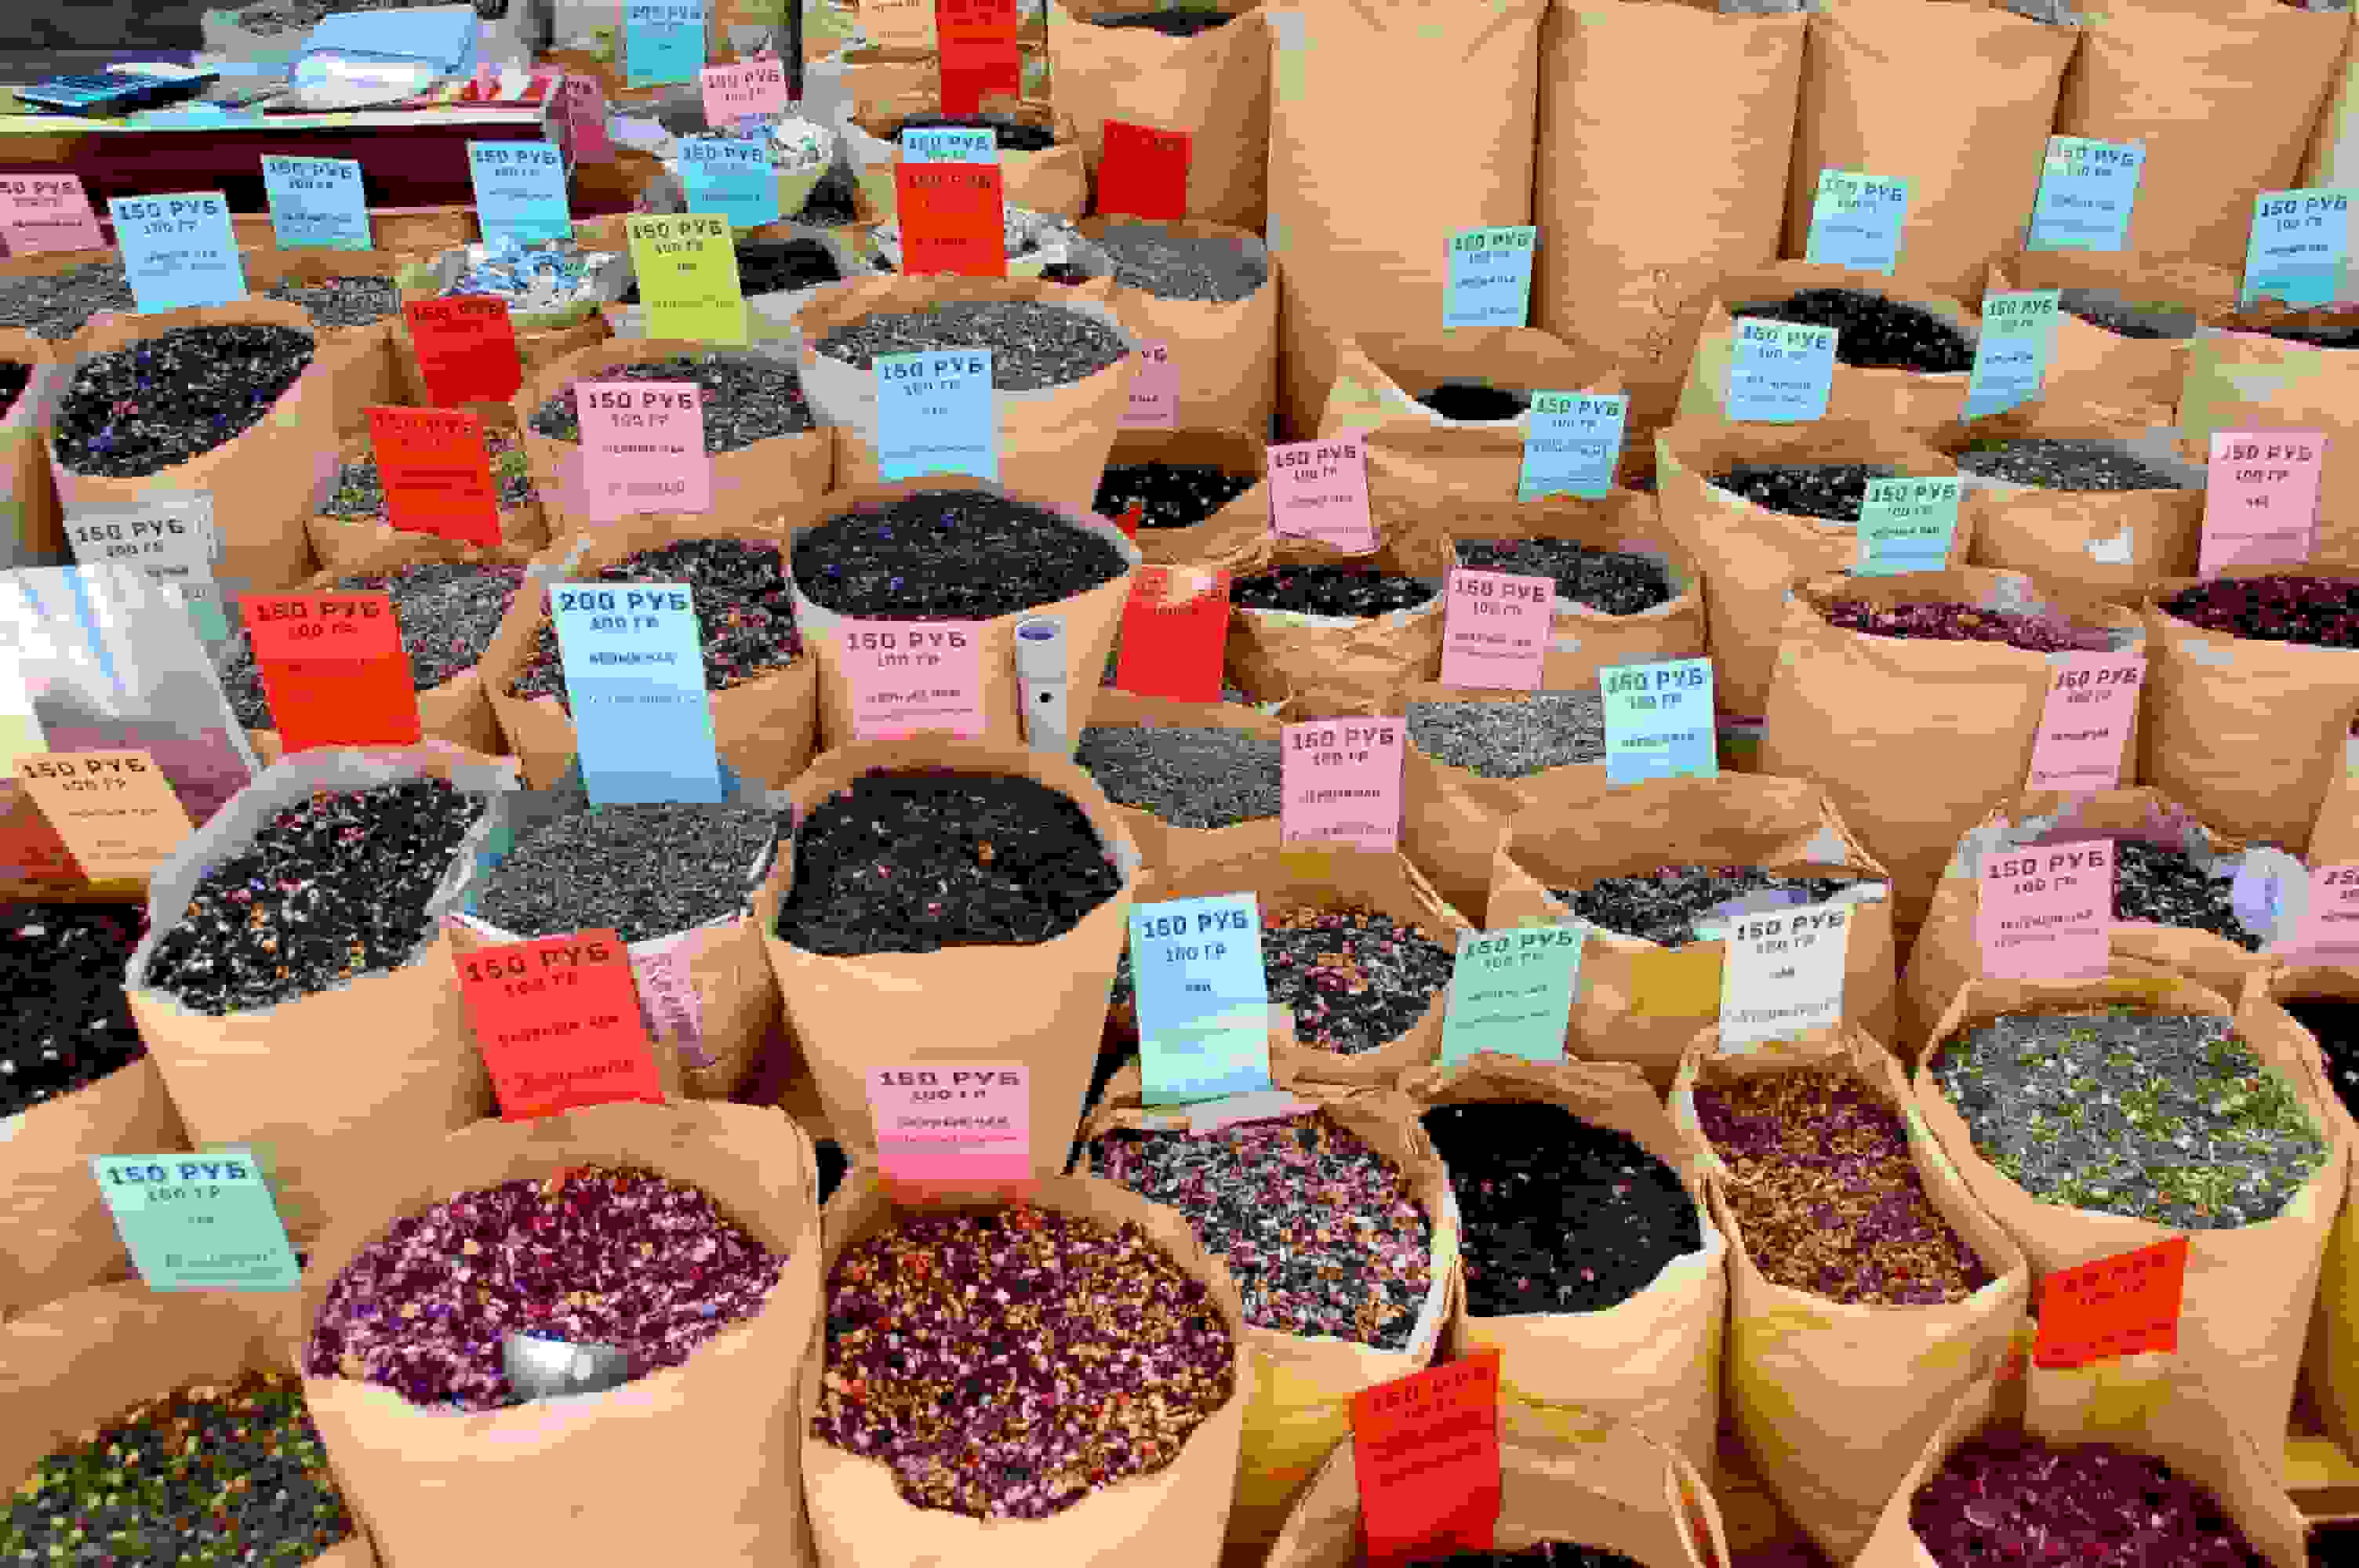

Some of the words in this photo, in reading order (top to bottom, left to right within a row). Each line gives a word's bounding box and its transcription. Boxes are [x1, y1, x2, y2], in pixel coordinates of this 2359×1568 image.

[119, 202, 162, 220] 150
[169, 200, 218, 218] РУБ
[2260, 199, 2298, 218] 150
[2306, 194, 2348, 212] РУБ
[632, 221, 672, 239] 150
[678, 219, 722, 238] РУБ
[883, 363, 924, 381] 150
[934, 358, 983, 379] РУБ
[590, 391, 631, 409] 150
[643, 391, 694, 409] РУБ
[1535, 398, 1570, 415] 150
[1579, 400, 1621, 418] РУБ
[1274, 449, 1310, 468] 150
[1317, 444, 1357, 463] РУБ
[2220, 444, 2260, 464] 150
[2265, 444, 2314, 464] РУБ
[1869, 483, 1909, 503] 150
[1914, 481, 1958, 502] РУБ
[76, 524, 122, 543] 150
[132, 518, 185, 540] РУБ
[559, 591, 617, 613] 200
[627, 590, 685, 612] РУБ
[1454, 579, 1494, 600] 150
[1501, 583, 1545, 603] РУБ
[256, 602, 304, 622] 150
[319, 601, 381, 619] РУБ
[846, 633, 897, 652] 150
[909, 631, 967, 650] РУБ
[1607, 672, 1646, 693] 150
[1656, 668, 1704, 691] РУБ
[2056, 669, 2092, 689] 150
[2095, 666, 2139, 687] РУБ
[1292, 730, 1335, 750] 150
[1344, 727, 1394, 748] РУБ
[23, 763, 75, 780] 150
[87, 758, 147, 775] РУБ
[1989, 858, 2037, 879] 150
[2048, 851, 2106, 873] РУБ
[1142, 916, 1187, 939] 150
[1198, 909, 1249, 935] РУБ
[1736, 919, 1781, 942] 150
[1790, 909, 1844, 931] РУБ
[1204, 942, 1227, 960] ГР
[1463, 938, 1510, 961] 150
[1519, 931, 1574, 950] РУБ
[467, 956, 527, 984] 150
[540, 942, 610, 968] РУБ
[878, 1071, 937, 1086] 150
[952, 1071, 1020, 1087] РУБ
[107, 1165, 165, 1185] 150
[176, 1161, 247, 1181] РУБ
